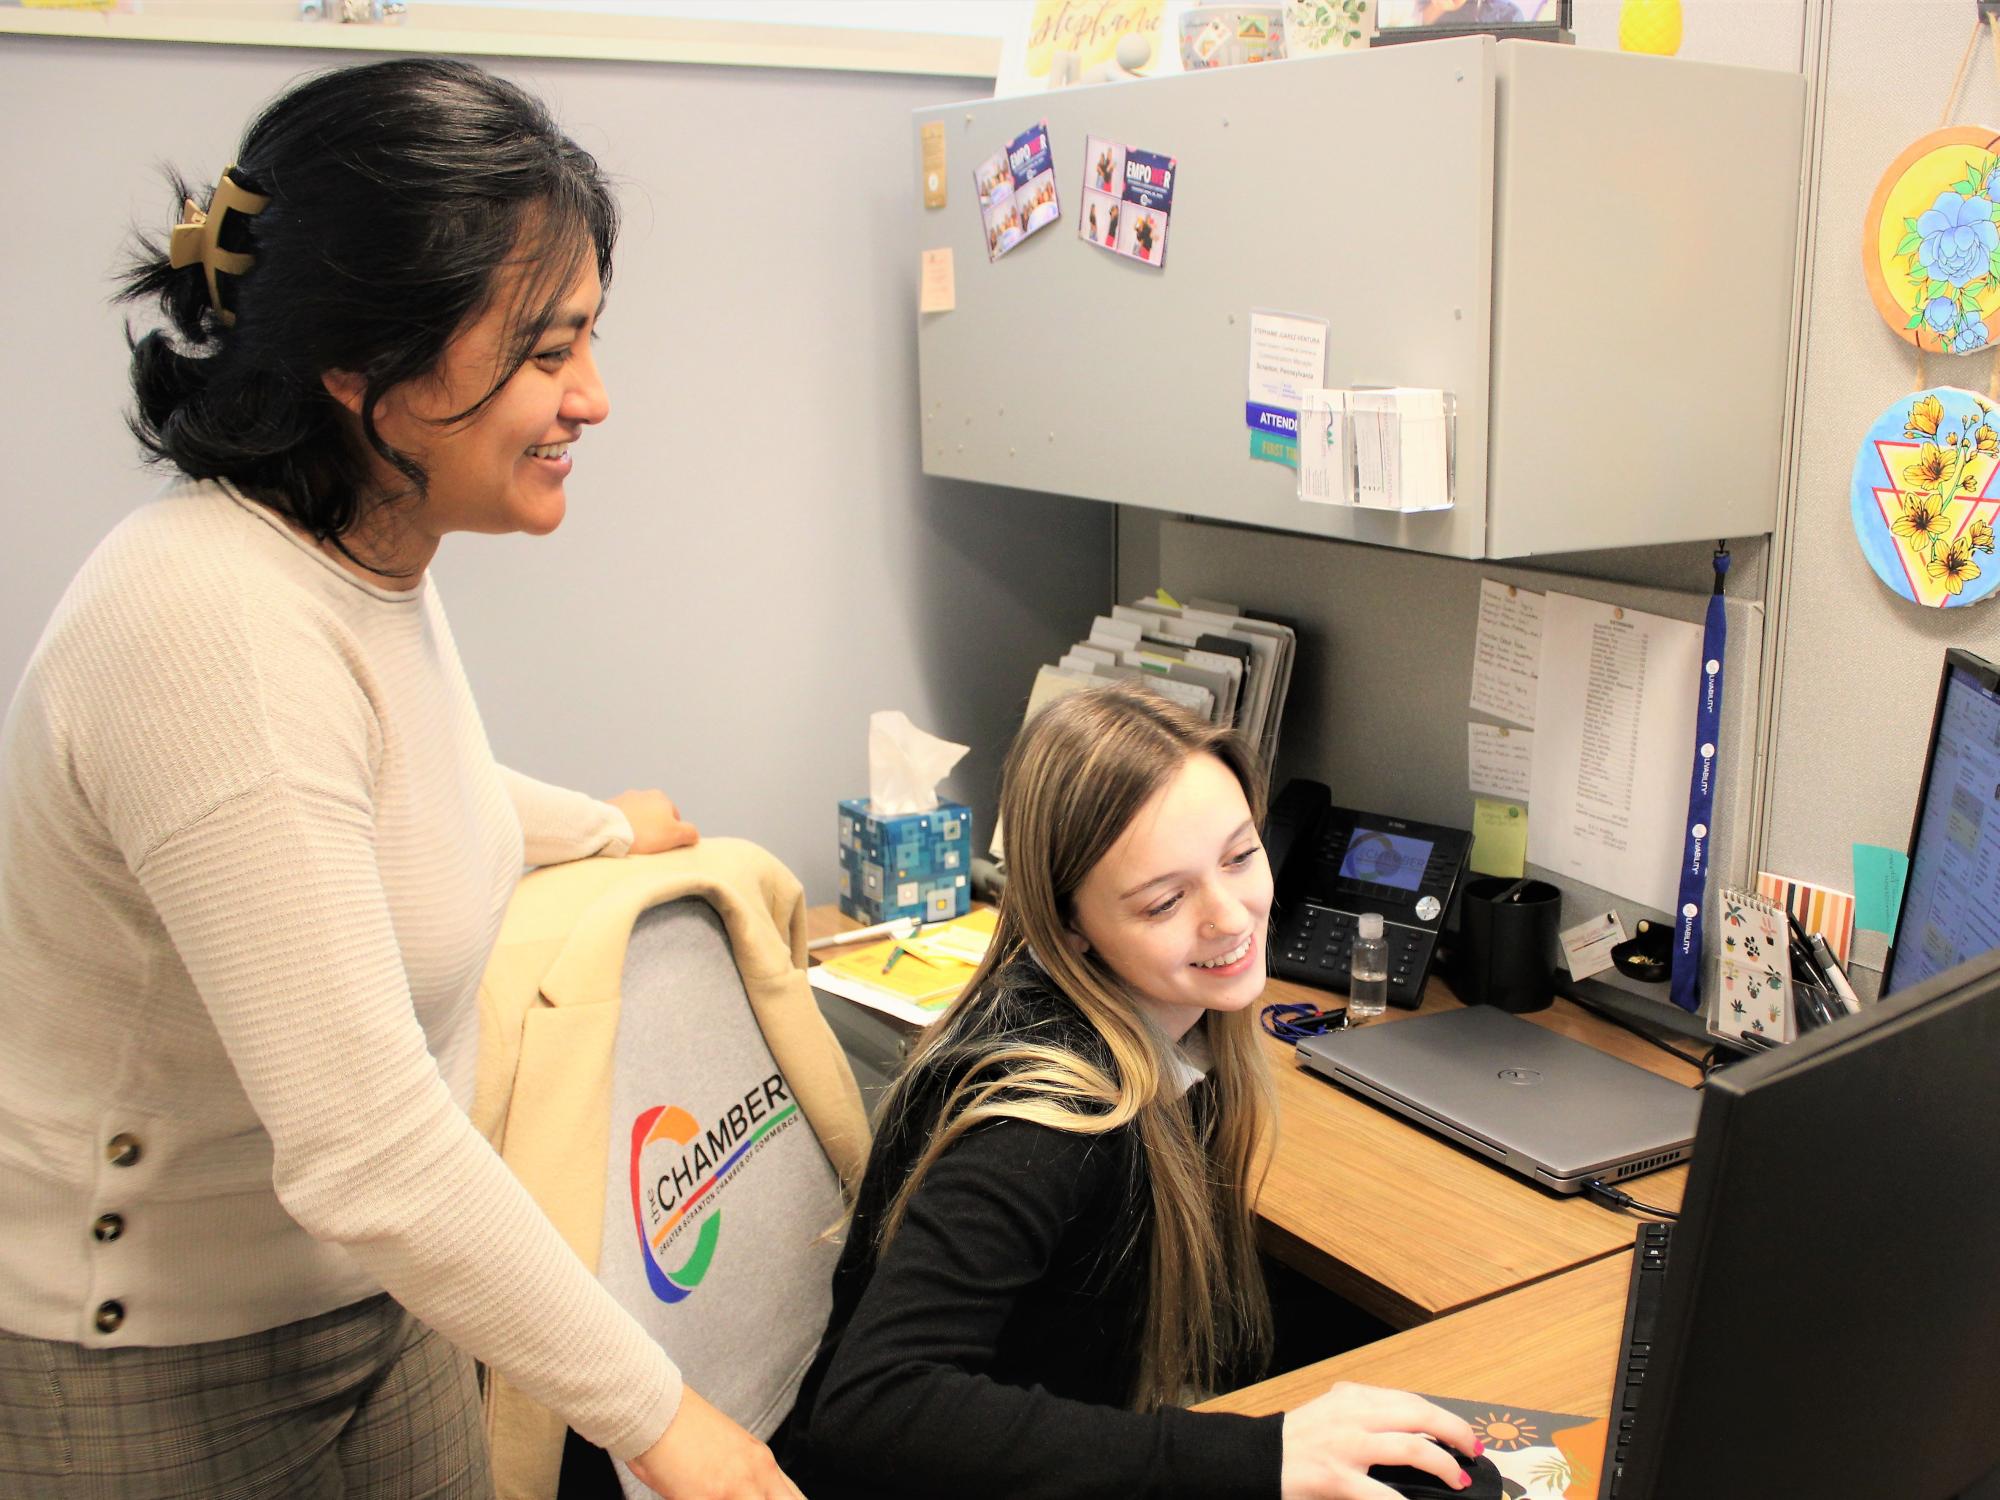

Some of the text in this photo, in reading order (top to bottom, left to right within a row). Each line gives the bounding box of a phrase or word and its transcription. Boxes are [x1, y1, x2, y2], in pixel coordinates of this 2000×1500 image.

[1126, 160, 1171, 189] EMPOWER
[657, 1073, 788, 1211] CHAMBER
[659, 1114, 799, 1255] GREATER SCRANTON CHAMBER OF COMMERCE
